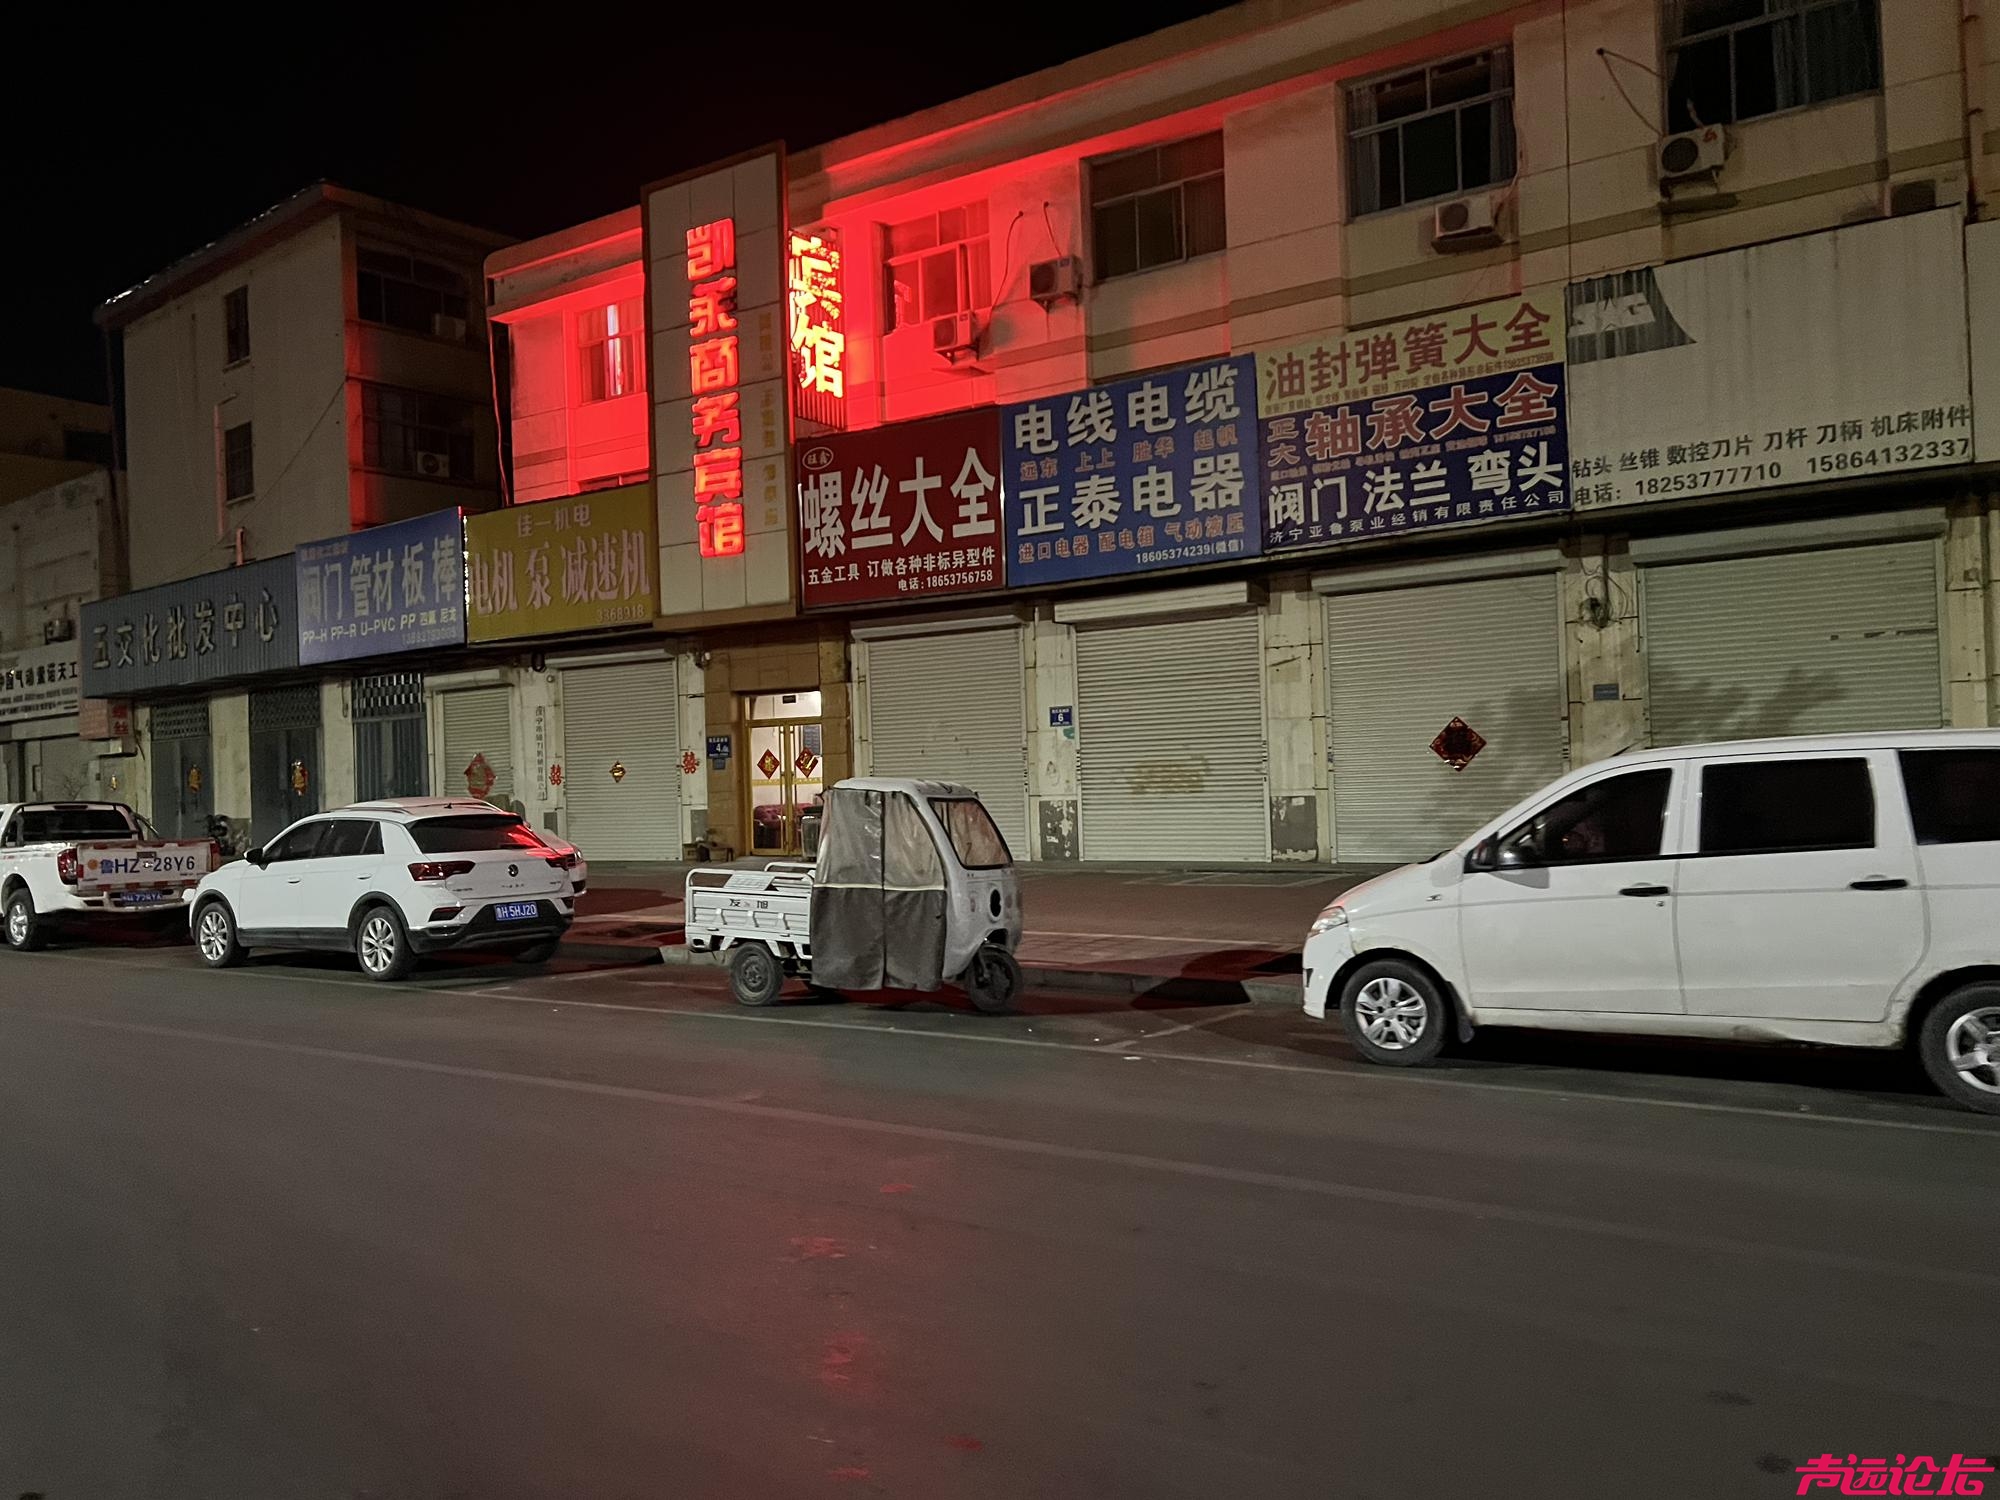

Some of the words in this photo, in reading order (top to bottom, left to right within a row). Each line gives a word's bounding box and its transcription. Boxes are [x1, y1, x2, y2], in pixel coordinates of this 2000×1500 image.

[1266, 304, 1550, 399] 油封弹簧大全
[1014, 365, 1240, 454] 电线电缆
[1305, 372, 1558, 460] 轴承大全
[1572, 456, 1612, 479] 钻头
[1619, 447, 1660, 472] 丝锥
[1667, 434, 1753, 467] 数控刀片
[1816, 419, 1862, 445] 刀柄
[1871, 404, 1969, 438] 机床附件
[1017, 452, 1245, 537] 正泰电器
[1074, 446, 1115, 473] 上上
[1268, 474, 1349, 530] 阀门
[1362, 460, 1452, 514] 法兰
[1467, 441, 1564, 497] 弯头
[1635, 462, 1782, 496] 18253777710
[1807, 438, 1969, 474] 15864132337
[804, 446, 995, 560] 螺丝大全
[561, 529, 650, 605] 减速机
[807, 562, 860, 586] 五金工具
[867, 547, 996, 578] 订做各种非标异型件
[1018, 534, 1090, 564] 进口电器
[360, 617, 396, 636] U-PVC
[400, 613, 416, 630] PP
